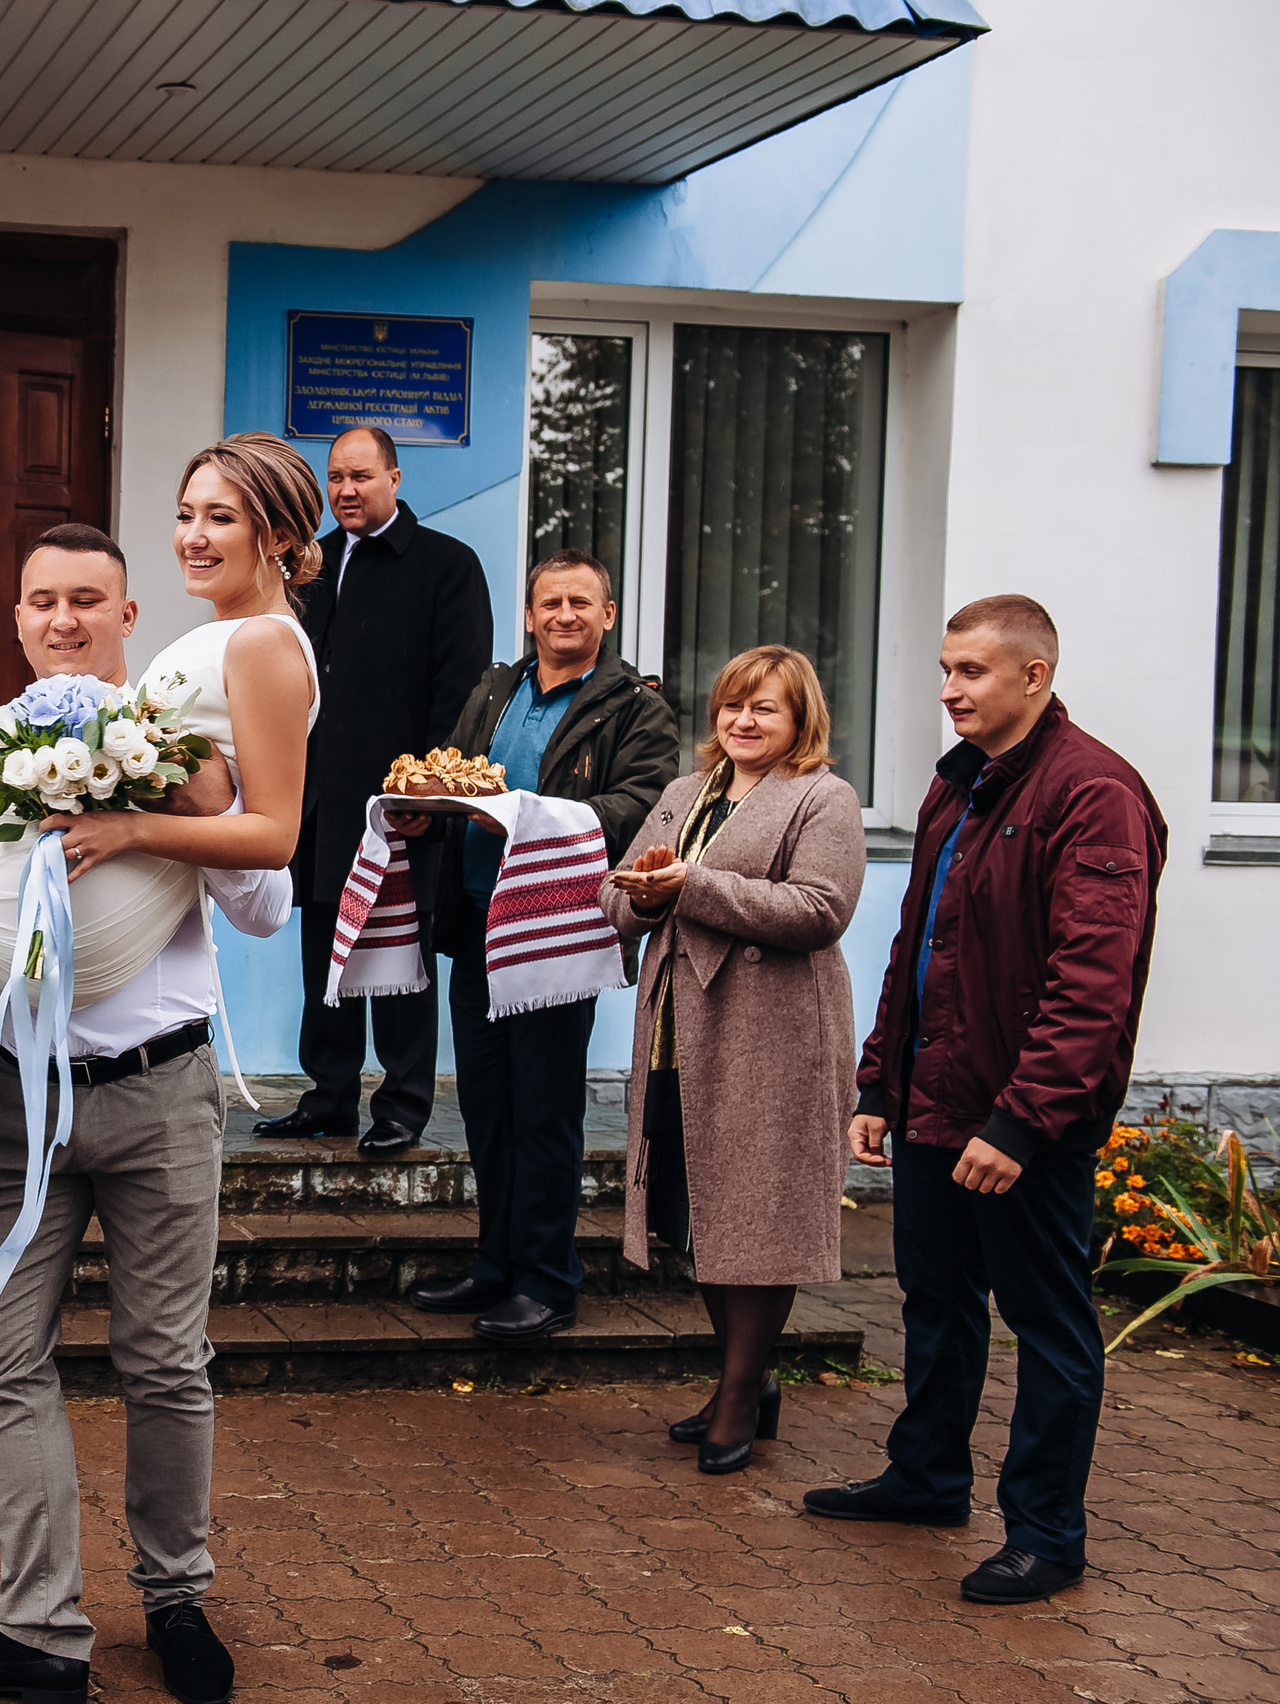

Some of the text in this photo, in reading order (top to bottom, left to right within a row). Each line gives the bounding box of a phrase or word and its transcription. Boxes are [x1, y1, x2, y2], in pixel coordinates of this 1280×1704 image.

[321, 344, 373, 353] МІНІСТЕРСТВО
[376, 346, 406, 354] ЮСТИЦІЇ
[298, 356, 462, 370] ЗАХІДНЕ МІЖРЕГІОНАЛЬНЕ УПРАВЛІННЯ
[309, 368, 368, 378] МІНІСТЕРСТВА
[371, 370, 407, 380] ЮСТИЦІЇ
[295, 385, 463, 401] ЗДОЛБУНІВСЬКИЙ РАЙОННИЙ ВІДДІЛ
[307, 400, 450, 414] ДЕРЖАВНОЇ РЕЄСТРАЦІЇ АКТІВ
[332, 415, 424, 427] ЦИВІЛЬНОГО СТАНУ
